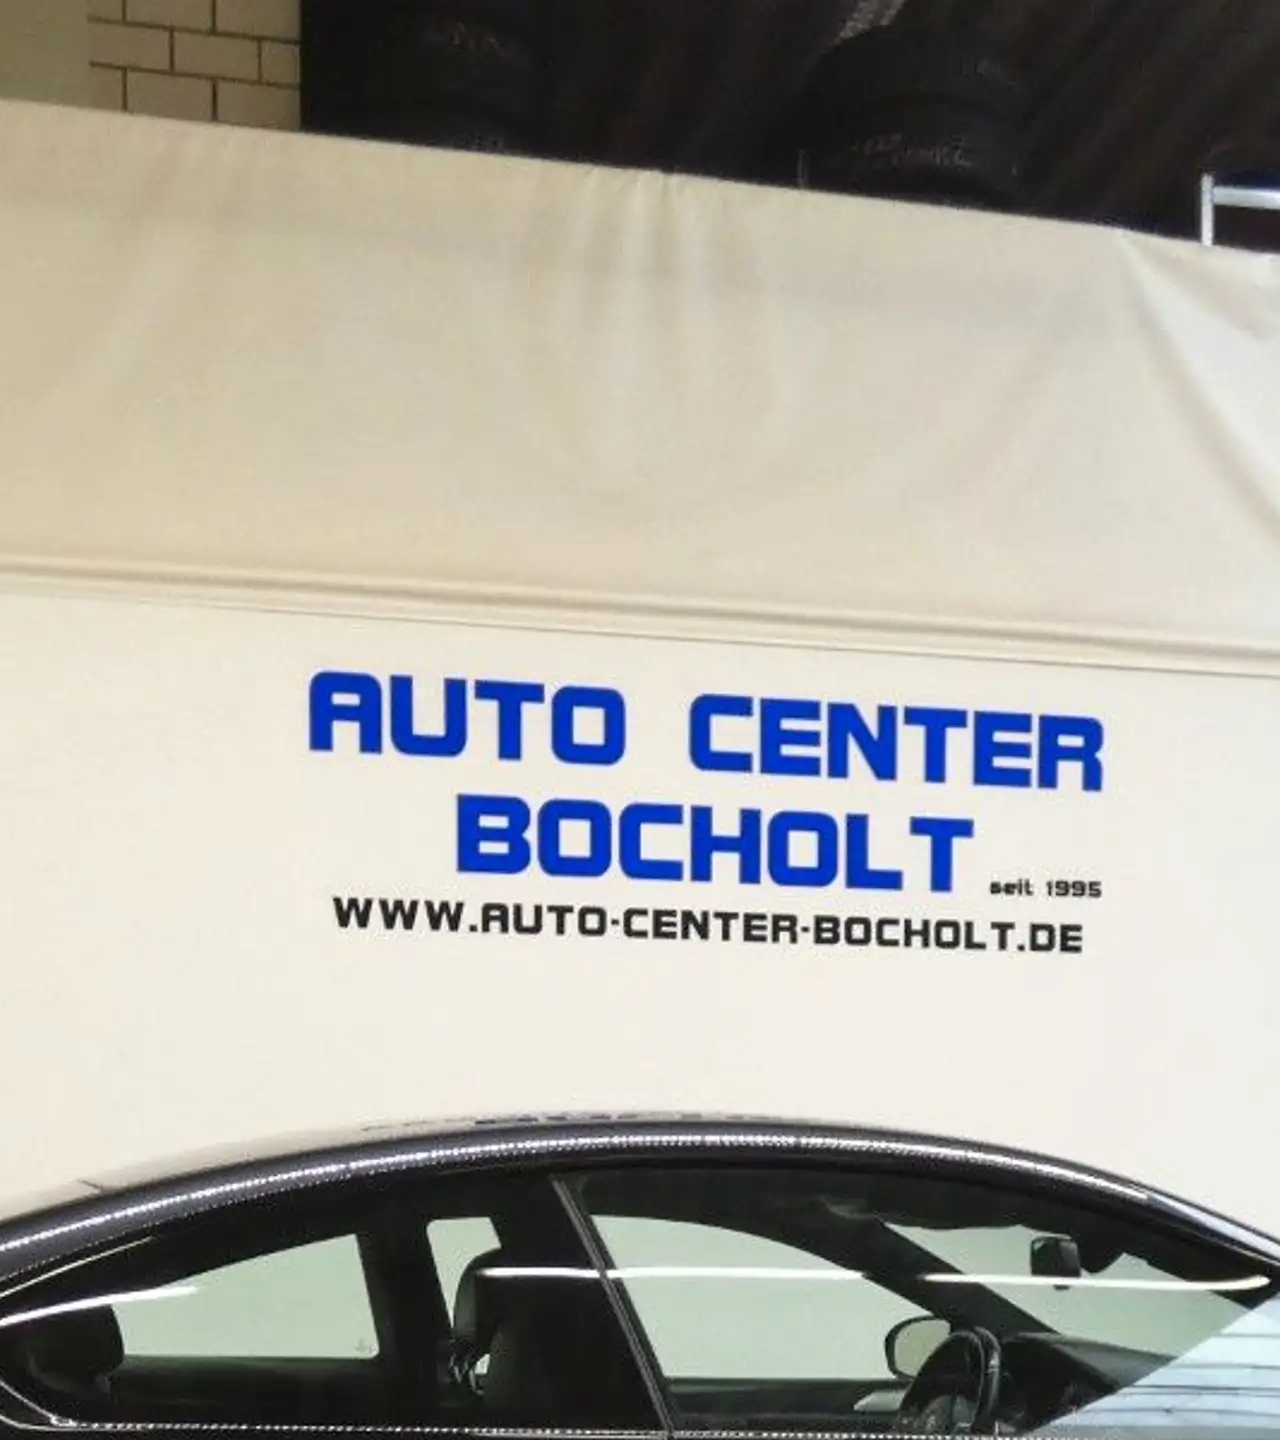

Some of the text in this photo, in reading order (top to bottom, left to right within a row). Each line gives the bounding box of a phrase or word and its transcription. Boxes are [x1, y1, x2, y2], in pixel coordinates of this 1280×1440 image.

[308, 670, 1104, 792] AUTO CENTER
[456, 792, 975, 893] BOCHOLT
[332, 896, 1084, 954] WWW.AUTO-CENTER-BOCHOLT.DE
[989, 878, 1102, 899] seit 1995
